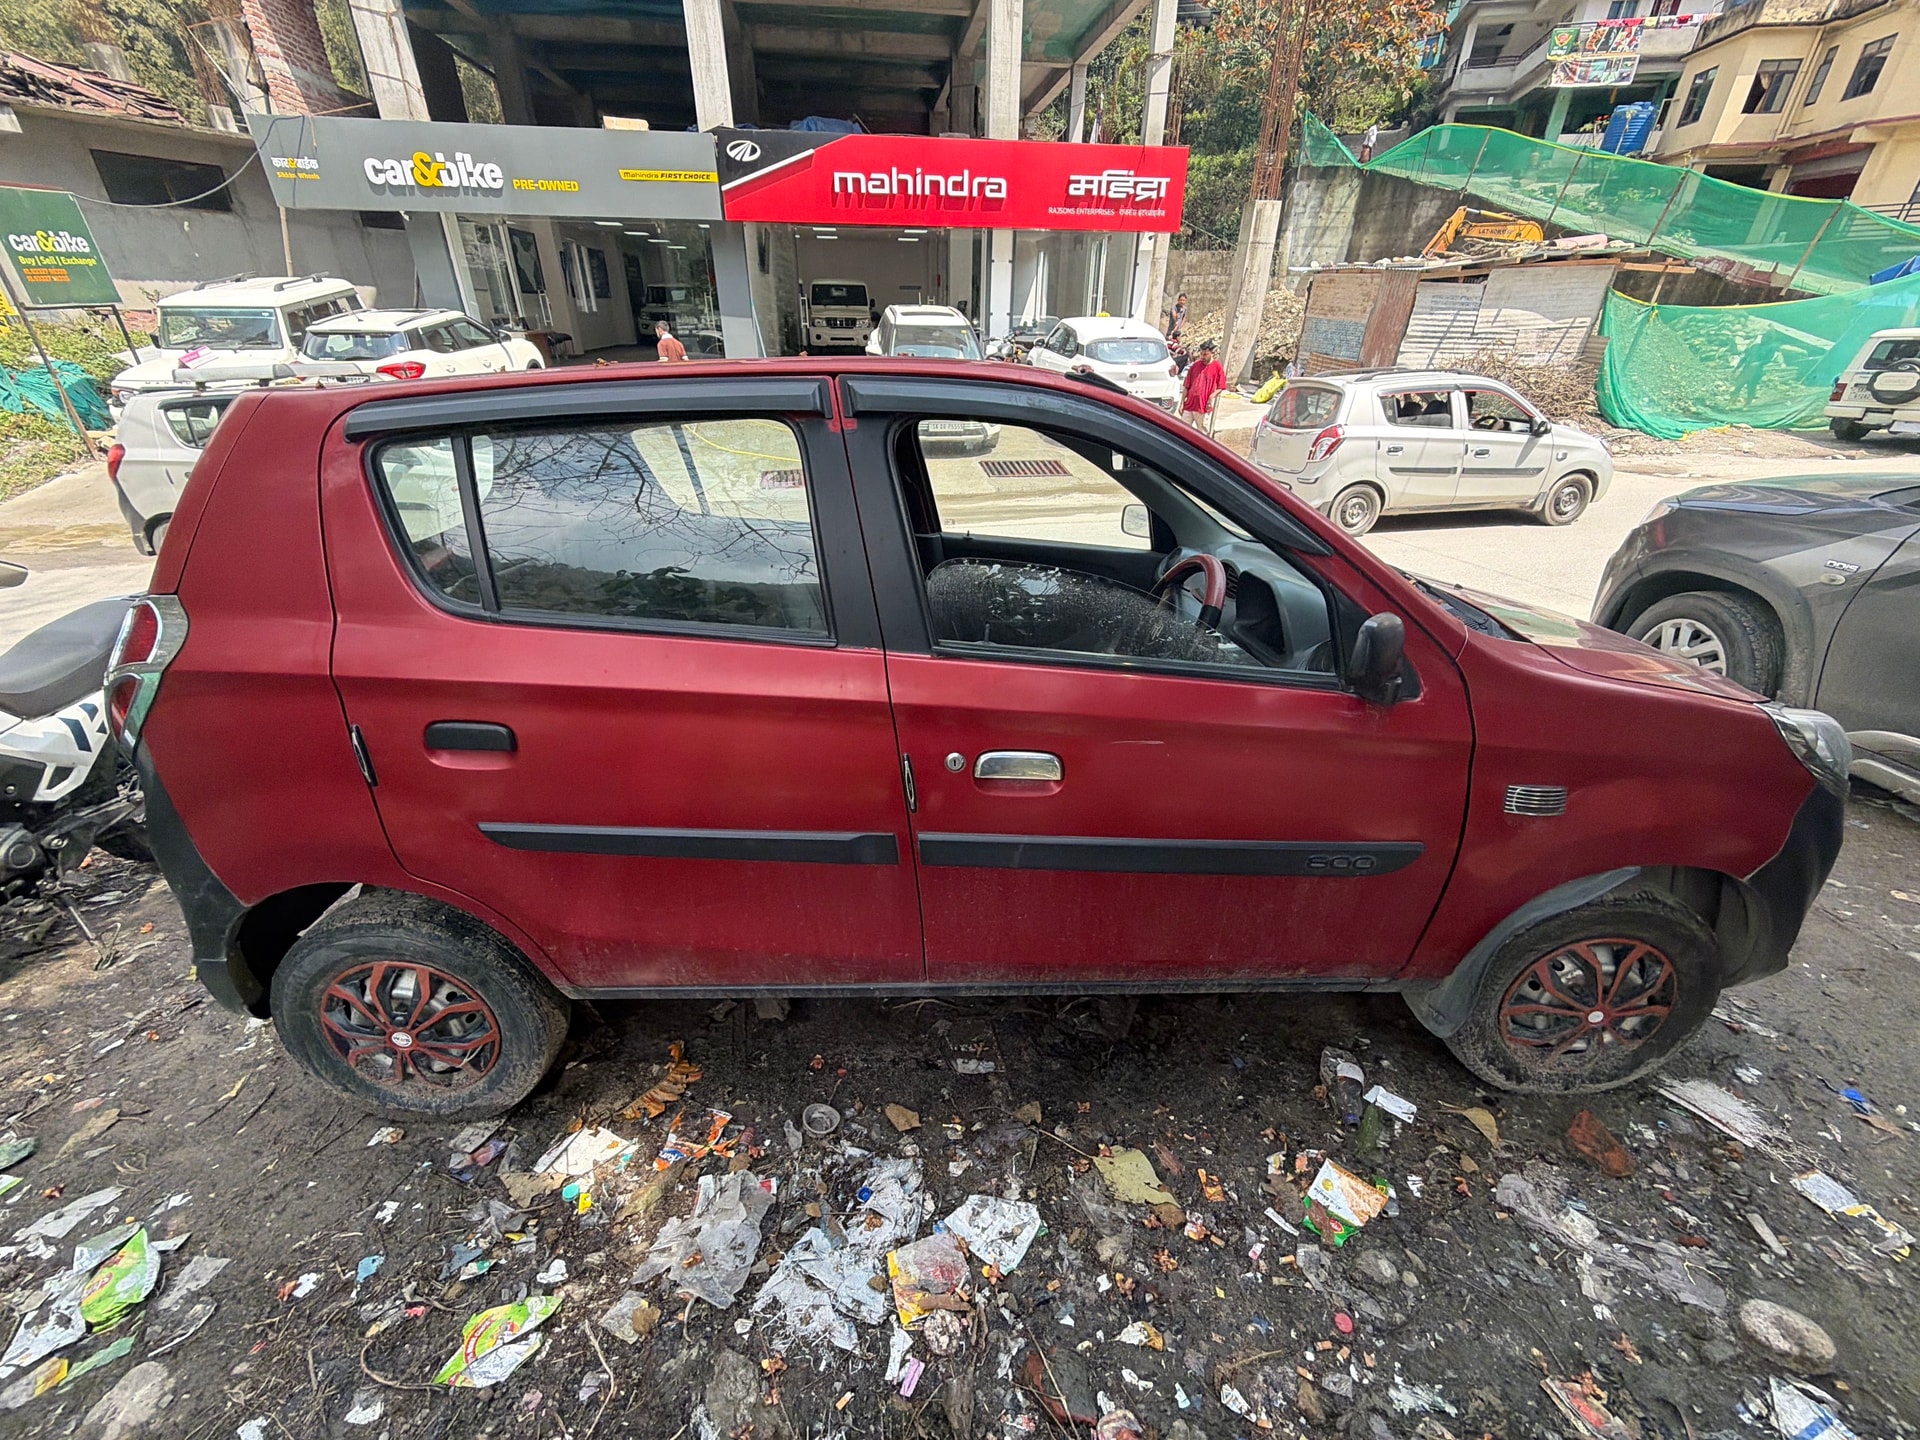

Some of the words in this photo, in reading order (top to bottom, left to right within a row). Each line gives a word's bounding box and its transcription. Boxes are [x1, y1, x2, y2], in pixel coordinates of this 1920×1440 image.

[364, 152, 504, 189] car&bike
[623, 171, 659, 179] Mahindra
[512, 179, 579, 192] PRE-OWNED
[833, 167, 1007, 198] mahindra
[1068, 169, 1171, 202] महिंद्रा
[1048, 207, 1076, 215] RAJSONS
[1076, 208, 1115, 216] ENTERPRISES
[8, 230, 90, 253] car&bike
[18, 255, 36, 265] Buy
[40, 256, 56, 265] Sell
[61, 256, 97, 267] Exchange
[1826, 559, 1860, 572] DDIS
[1306, 854, 1376, 869] 800
